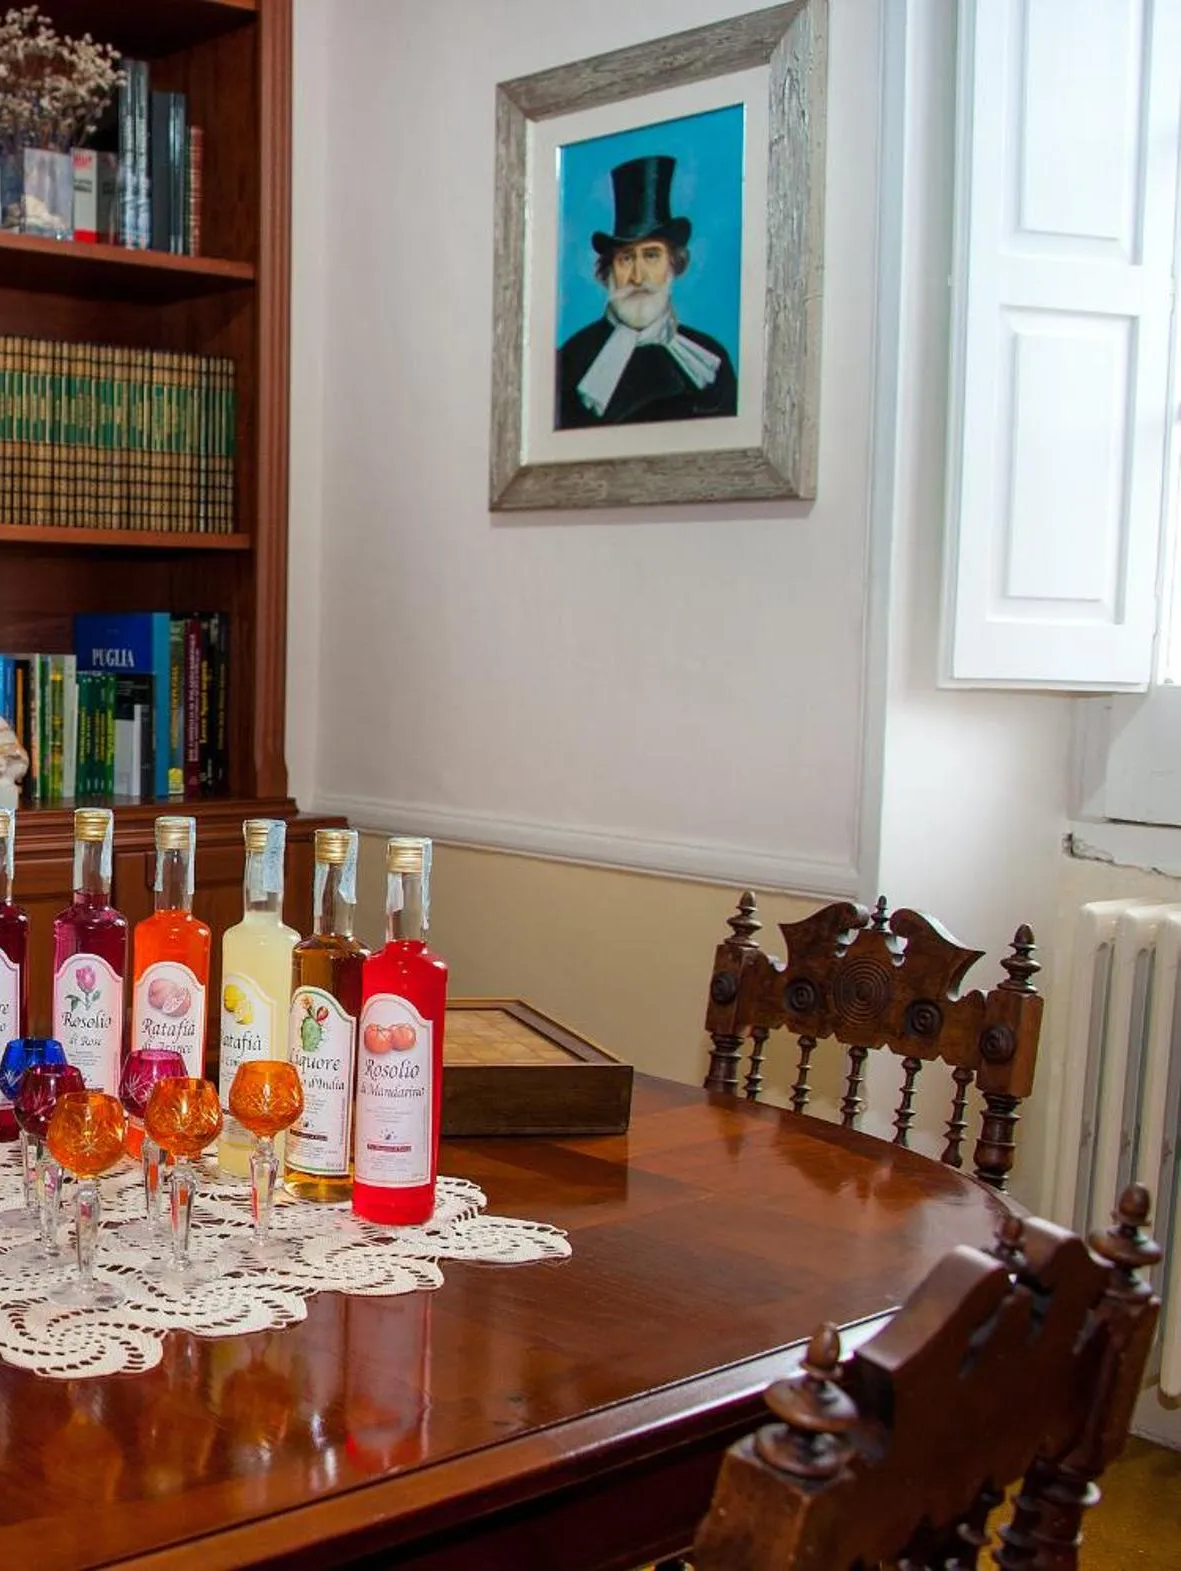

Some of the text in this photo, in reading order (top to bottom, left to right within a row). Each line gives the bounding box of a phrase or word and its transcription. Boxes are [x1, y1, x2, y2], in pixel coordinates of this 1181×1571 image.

[91, 648, 136, 669] PUGLIA
[61, 1009, 112, 1029] Rosolio
[222, 1030, 262, 1058] atafià
[364, 1057, 421, 1081] Rosolio
[367, 1082, 426, 1099] Mandarino
